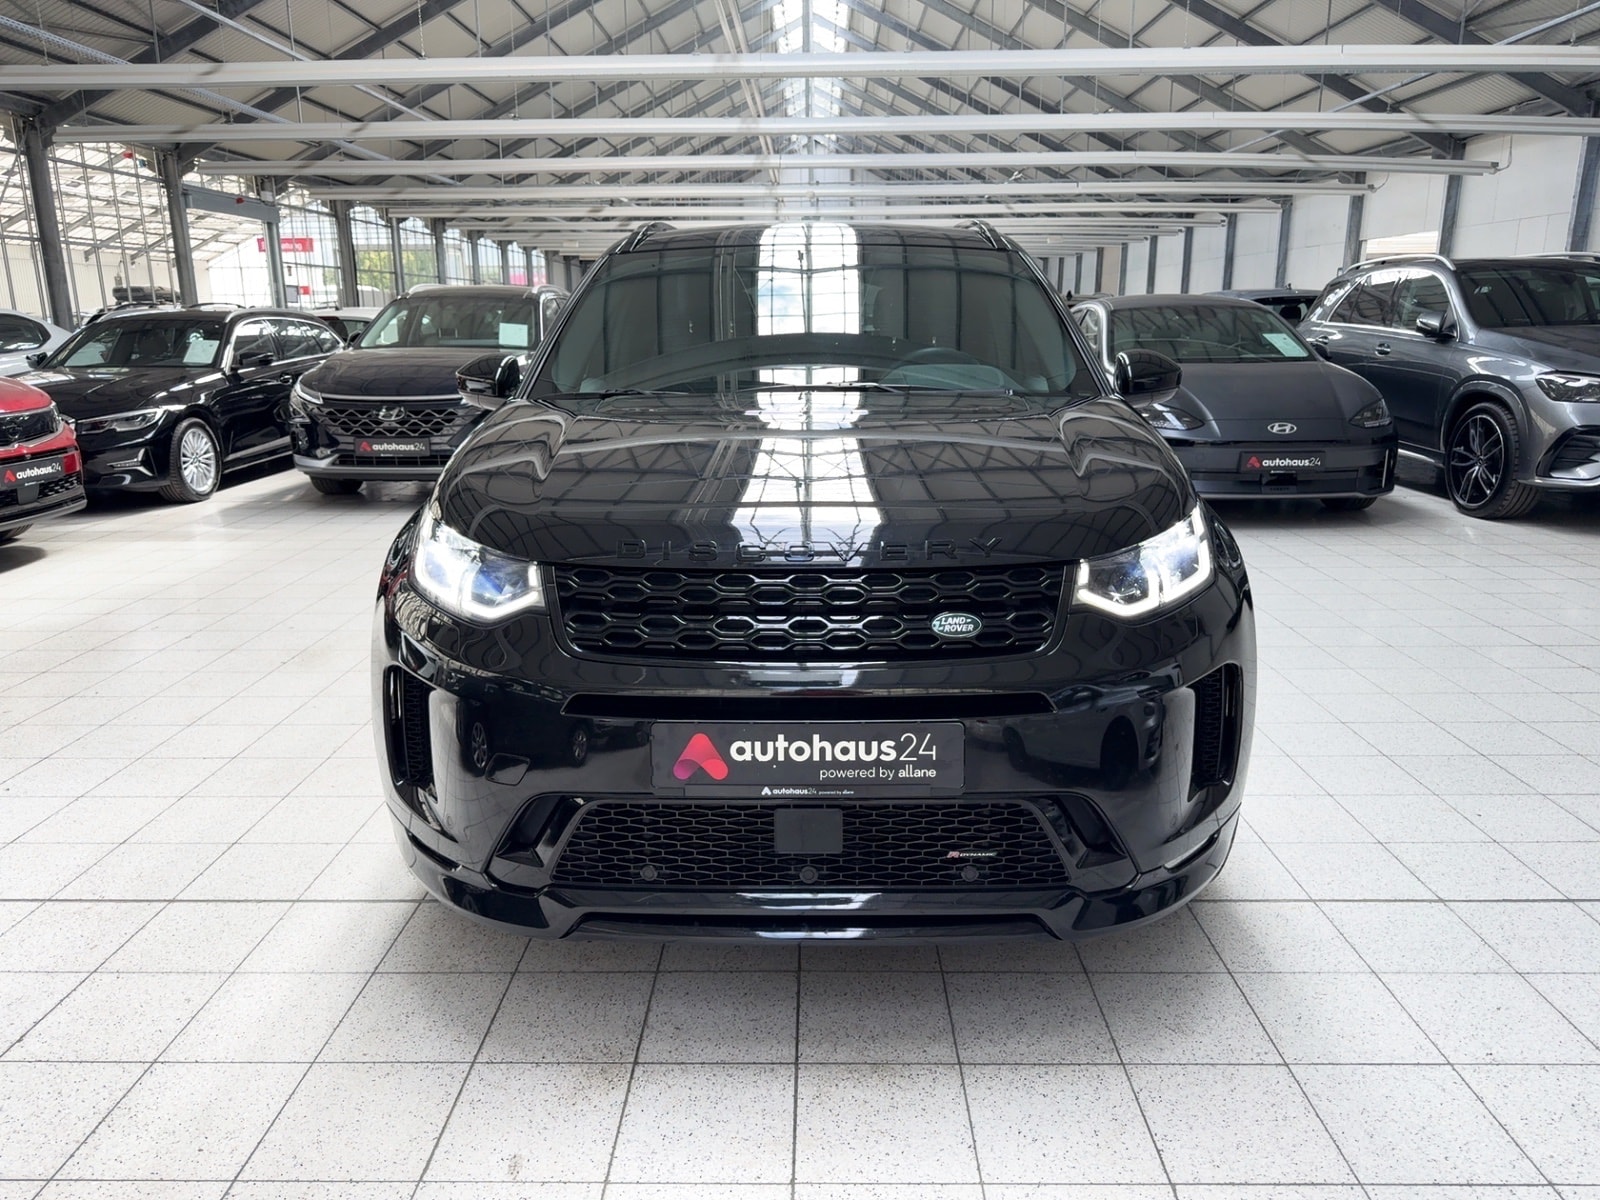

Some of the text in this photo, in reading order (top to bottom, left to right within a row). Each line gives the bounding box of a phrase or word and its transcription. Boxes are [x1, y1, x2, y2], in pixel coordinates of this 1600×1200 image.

[371, 442, 426, 451] autohaus24
[1262, 457, 1321, 467] autohaus24
[16, 462, 62, 479] autohaus24
[616, 536, 1003, 563] DISCOVERY
[943, 623, 974, 632] ROVER
[729, 732, 937, 762] autohaus24
[819, 764, 937, 780] powered by allane
[772, 787, 817, 795] autohaus24
